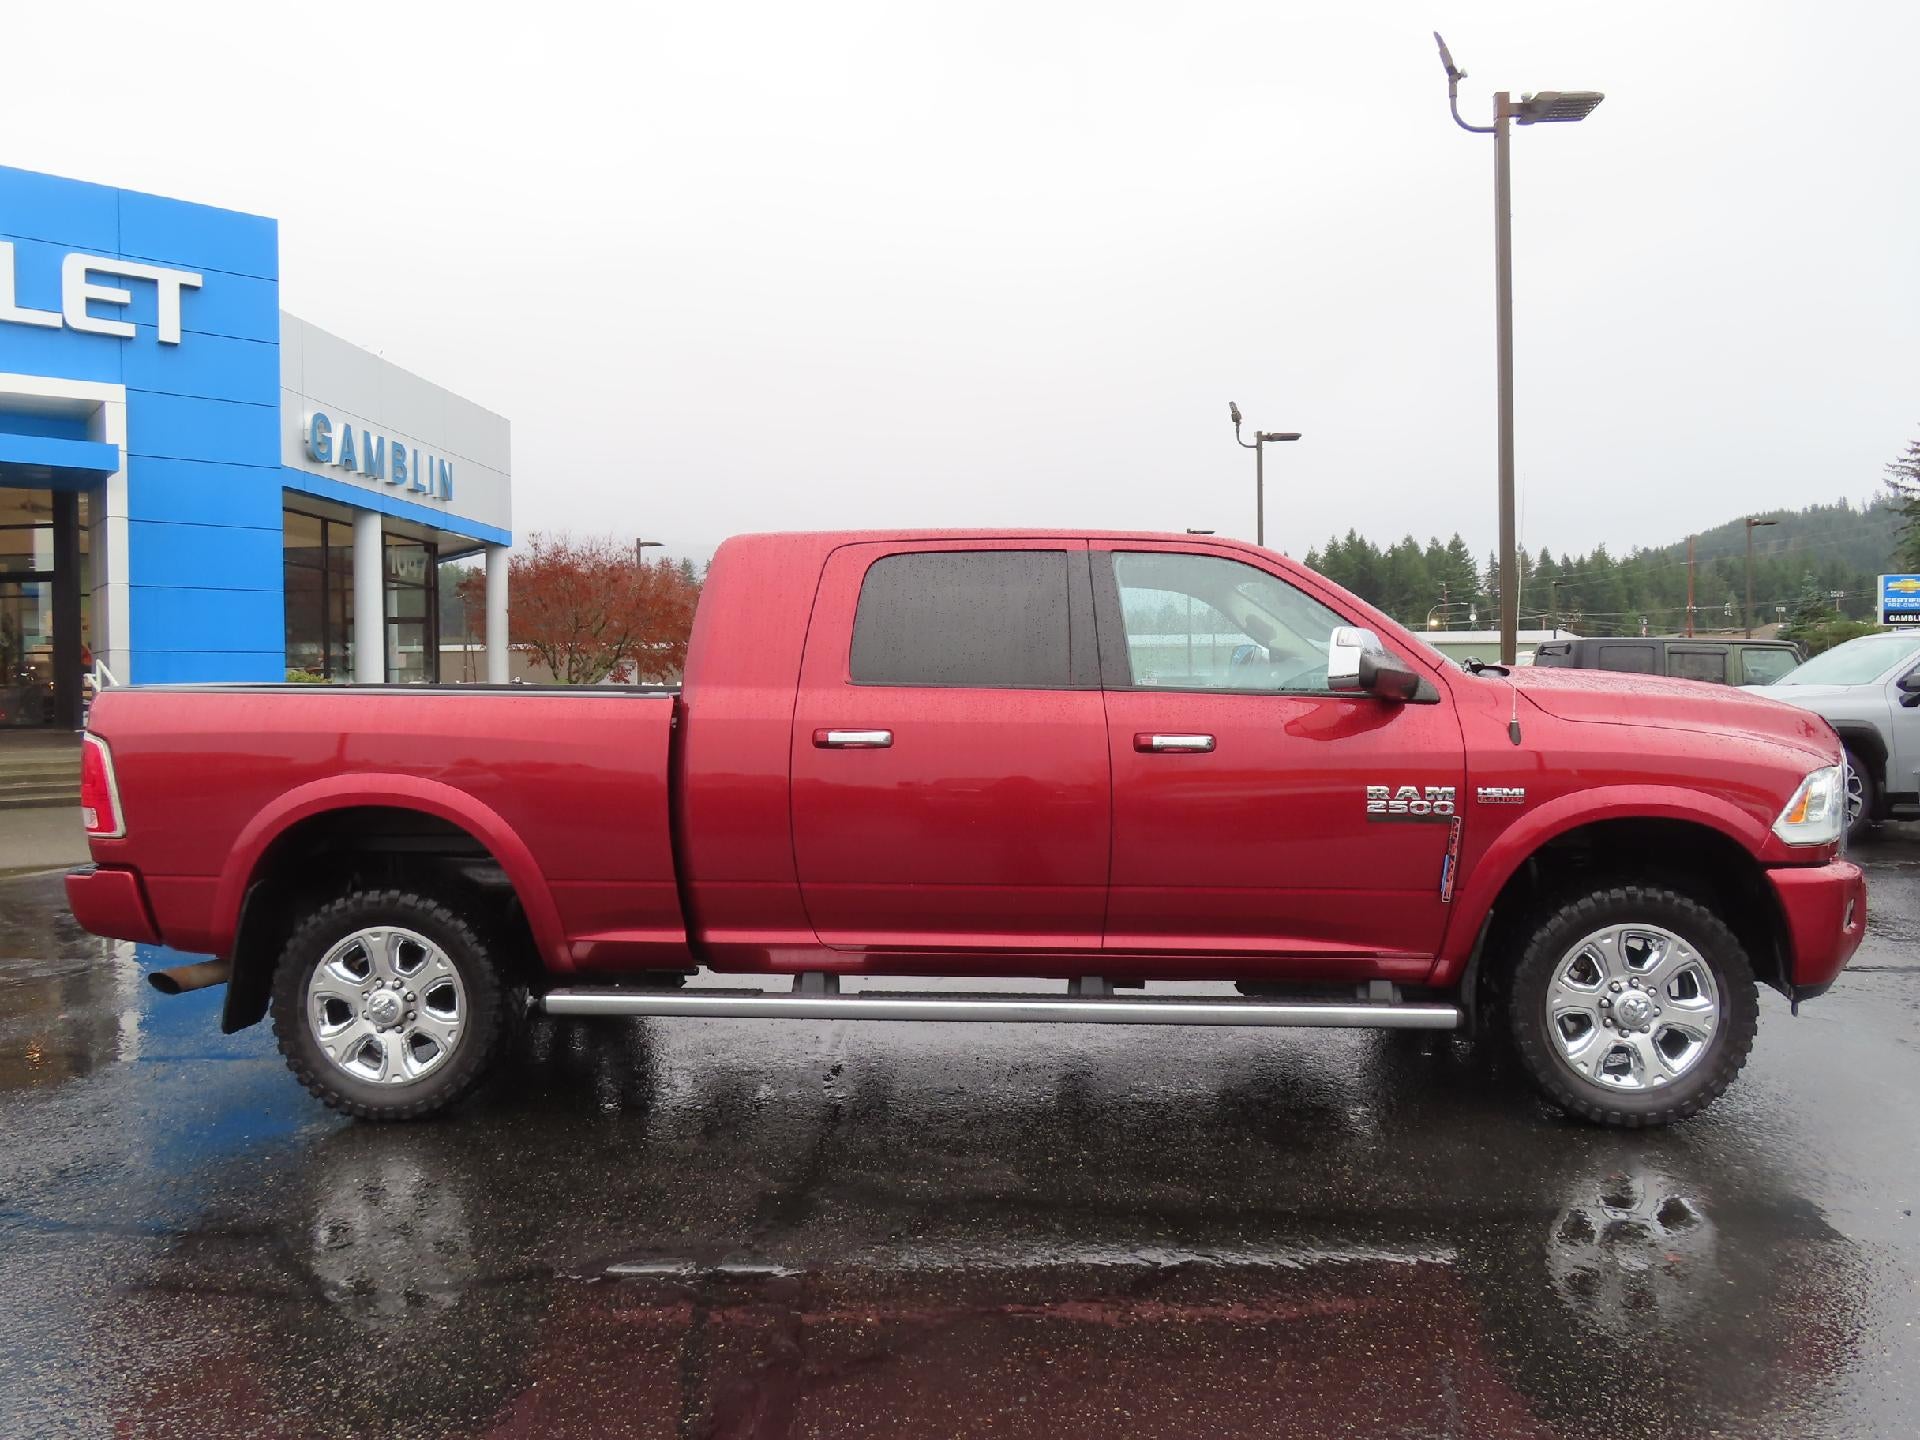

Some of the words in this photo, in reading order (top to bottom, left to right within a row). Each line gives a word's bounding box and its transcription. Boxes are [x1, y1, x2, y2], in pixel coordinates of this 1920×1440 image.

[308, 411, 453, 501] GAMBLIN
[1366, 785, 1456, 800] RAM
[1477, 787, 1525, 796] HEMI
[1366, 800, 1455, 815] 2500
